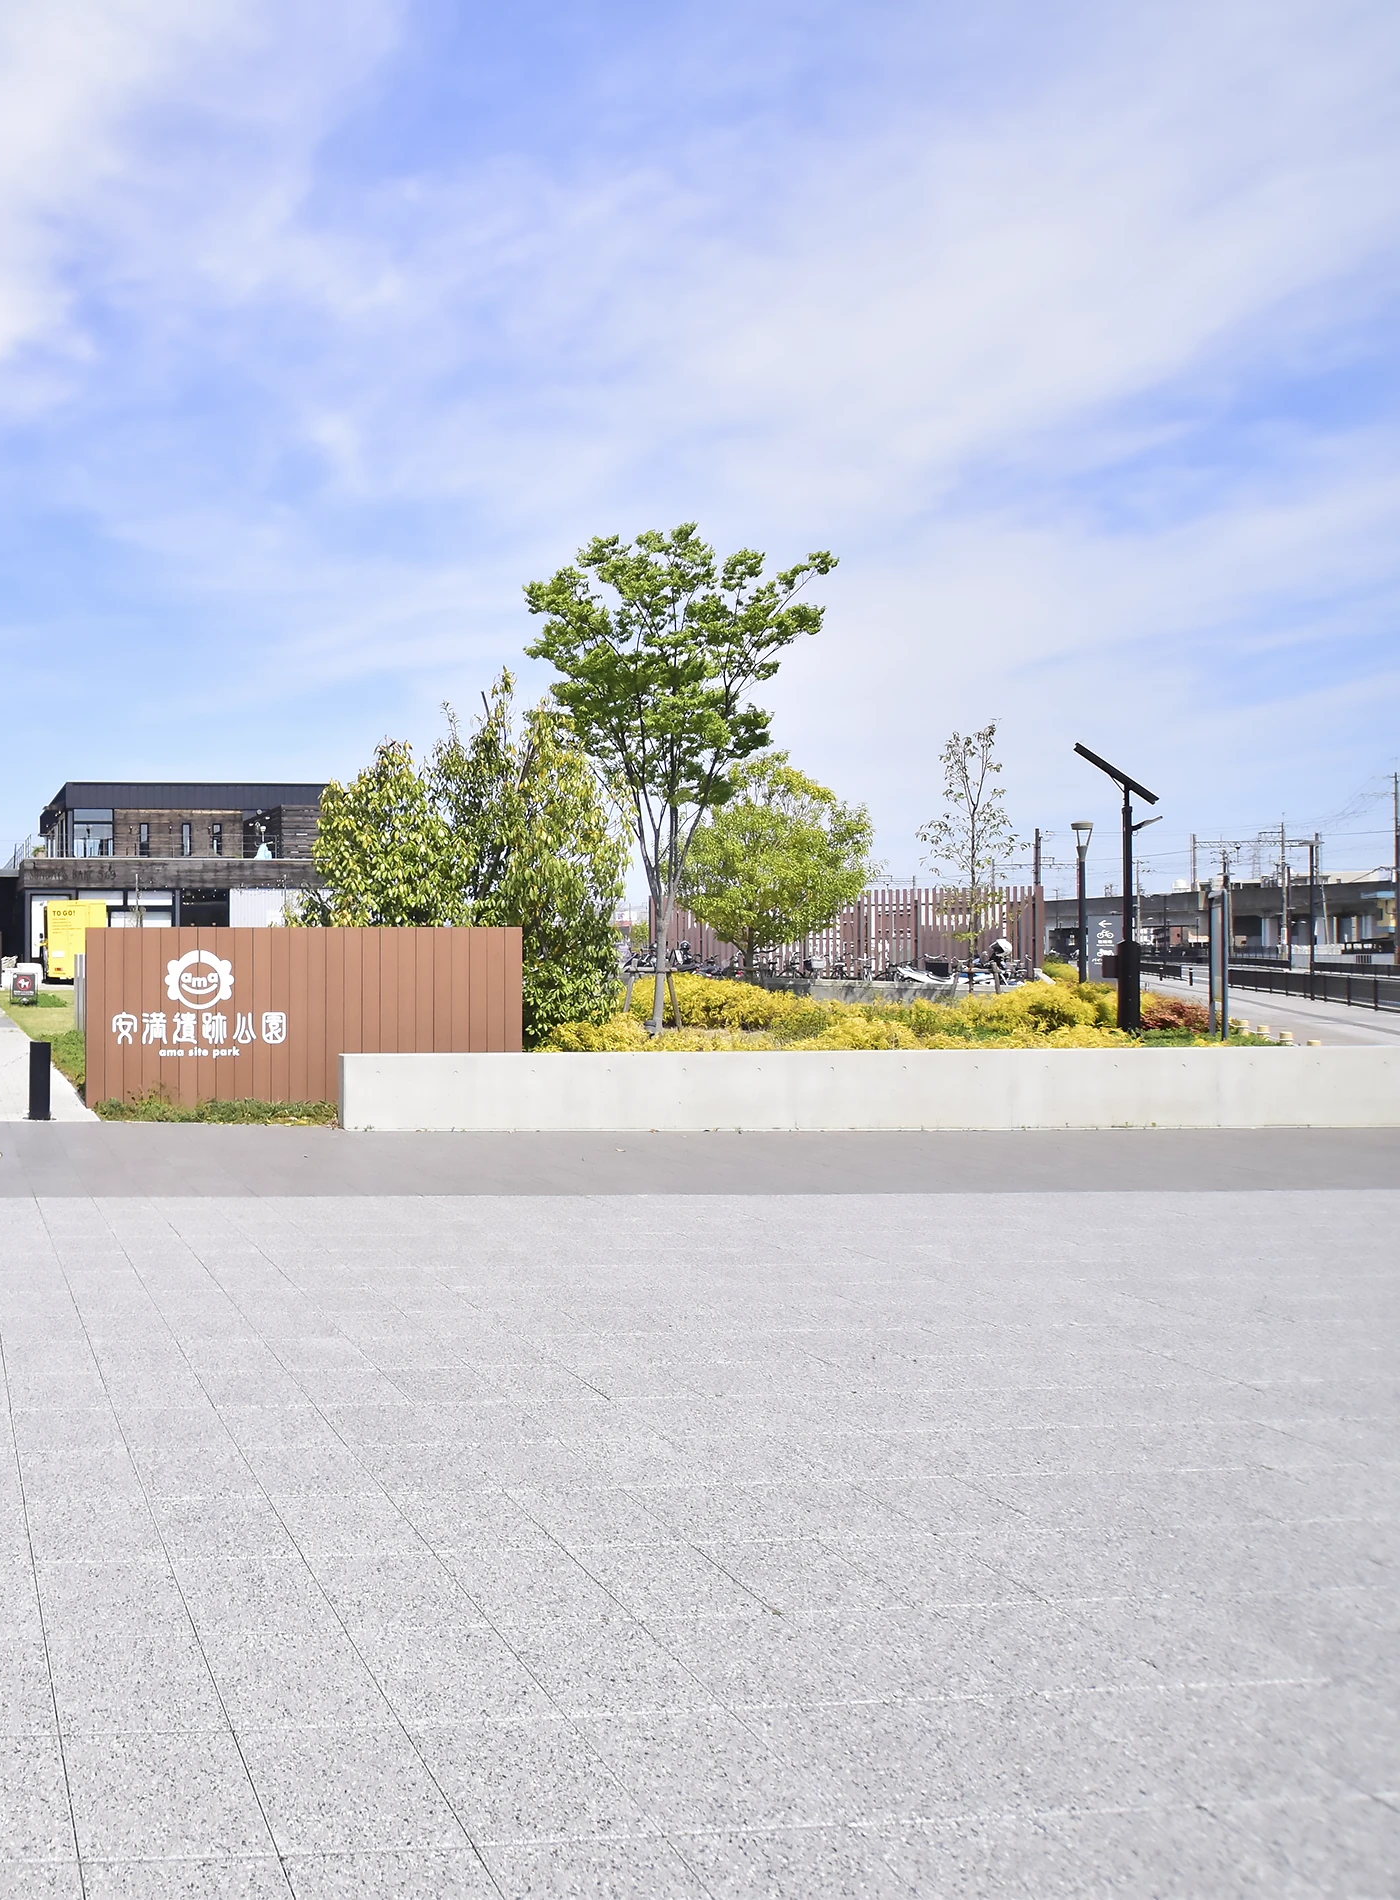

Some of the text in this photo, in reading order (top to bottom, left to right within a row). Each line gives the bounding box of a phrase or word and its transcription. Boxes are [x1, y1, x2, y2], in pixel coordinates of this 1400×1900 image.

[180, 972, 219, 988] ama
[112, 1011, 287, 1045] 安満遺跡公園
[158, 1046, 240, 1059] ama site park
